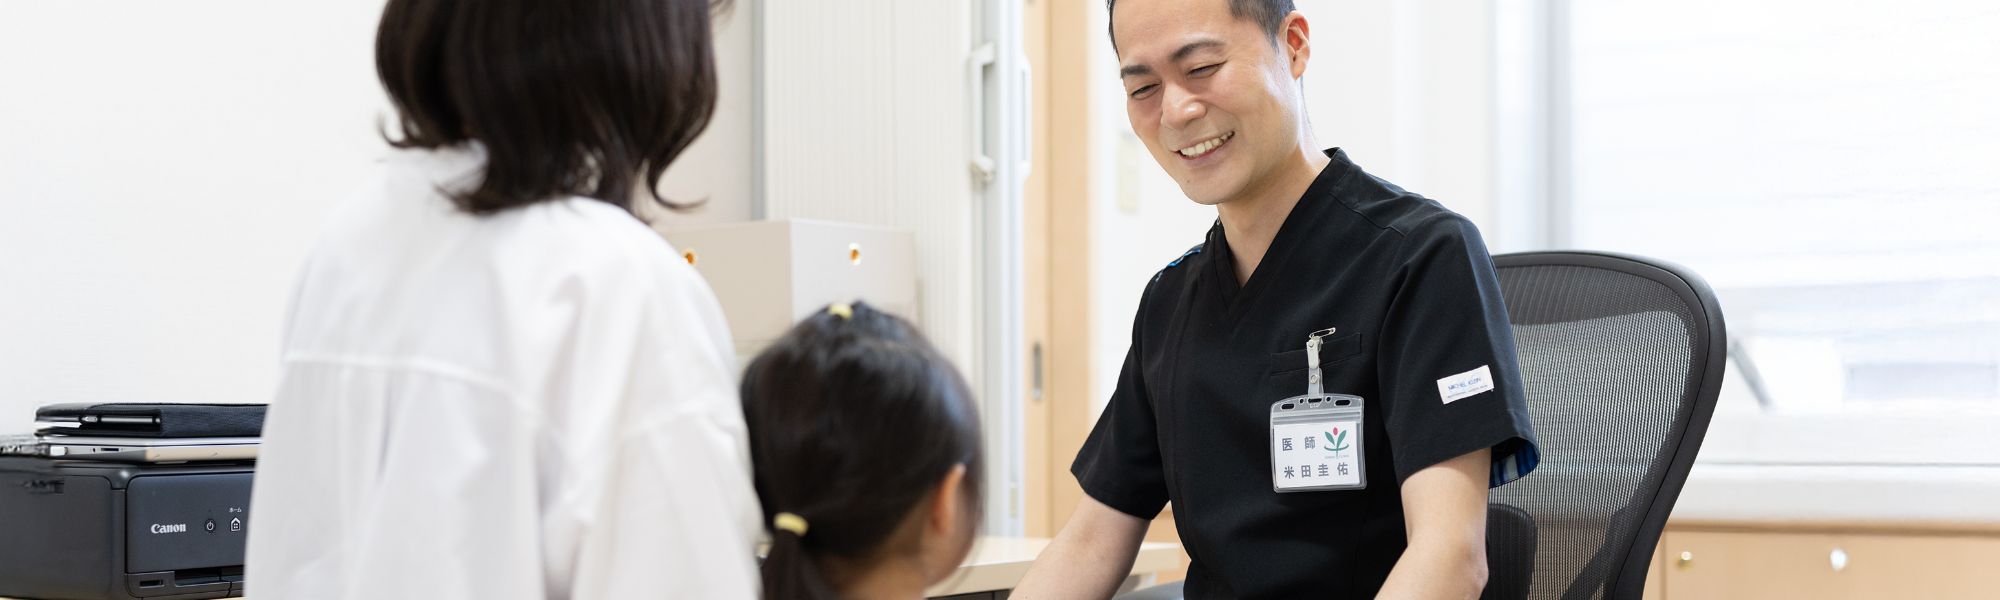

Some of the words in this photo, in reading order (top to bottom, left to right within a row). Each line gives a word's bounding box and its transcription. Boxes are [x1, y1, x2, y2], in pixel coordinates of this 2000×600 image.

[1282, 436, 1316, 451] 医師
[1284, 462, 1349, 479] 米田圭佑
[150, 523, 187, 534] Canon
